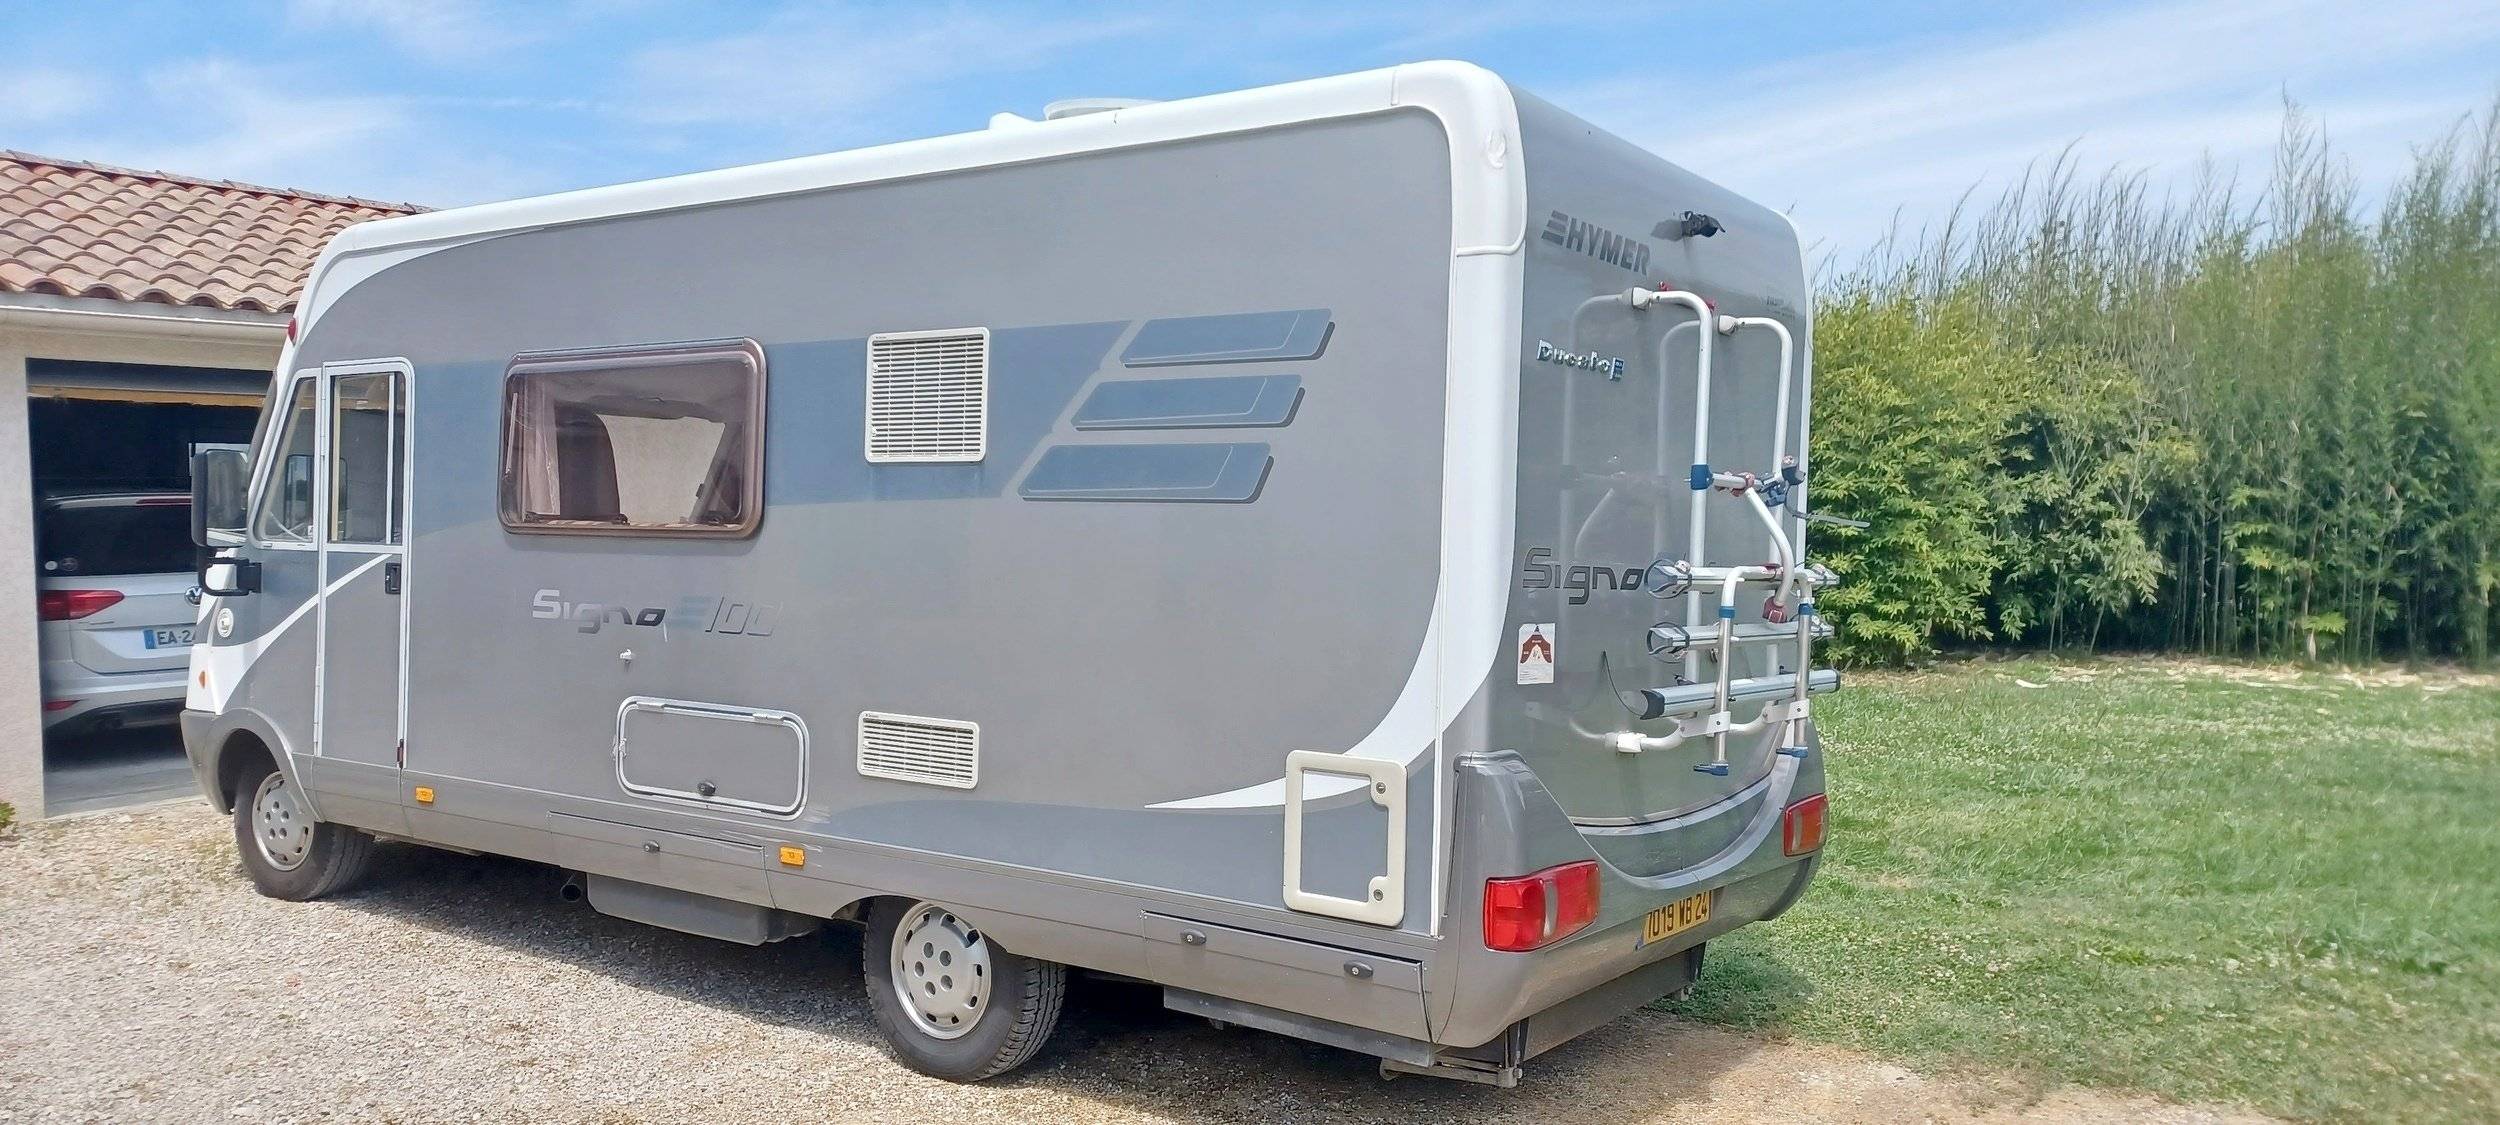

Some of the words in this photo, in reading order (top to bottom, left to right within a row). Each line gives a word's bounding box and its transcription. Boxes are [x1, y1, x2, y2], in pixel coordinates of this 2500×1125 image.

[1566, 218, 1650, 275] HYMER
[1523, 547, 1645, 605] Signo
[532, 588, 667, 634] Signo
